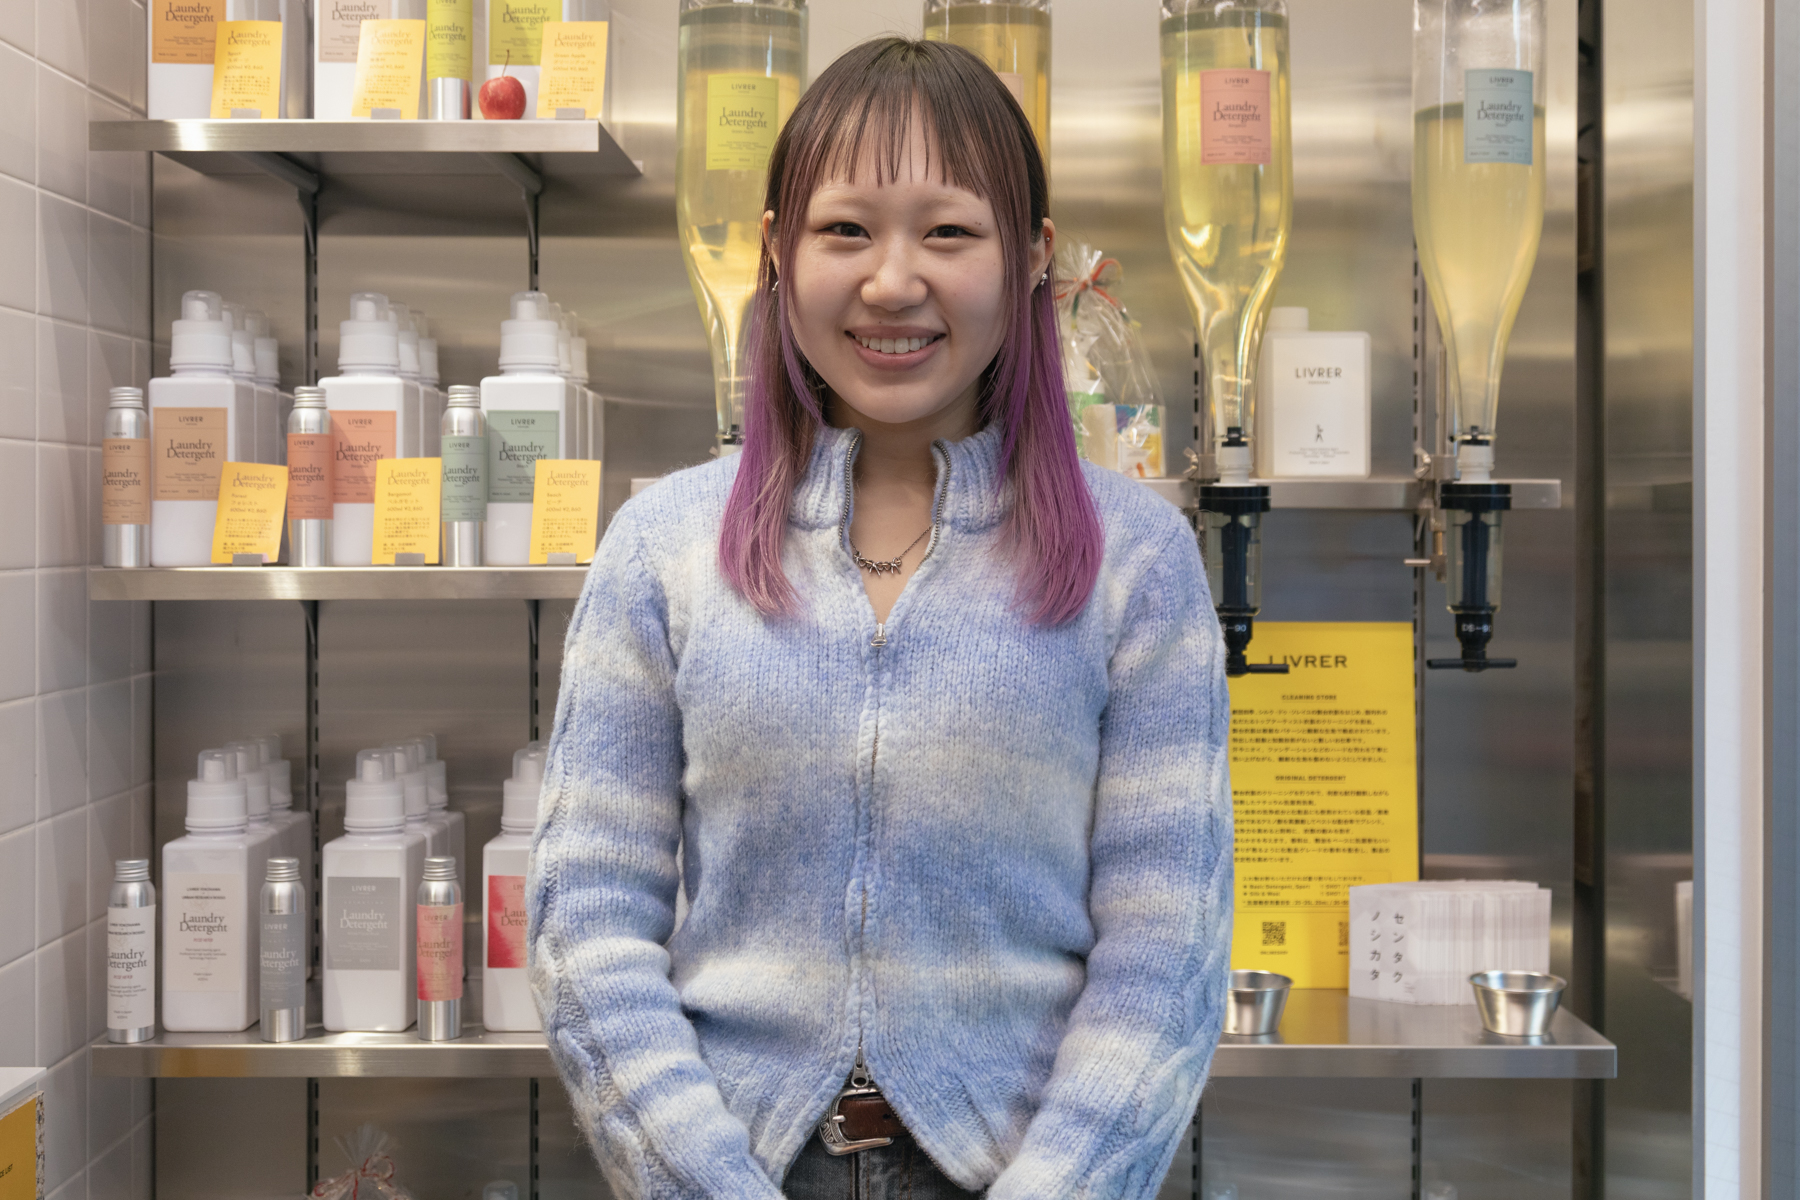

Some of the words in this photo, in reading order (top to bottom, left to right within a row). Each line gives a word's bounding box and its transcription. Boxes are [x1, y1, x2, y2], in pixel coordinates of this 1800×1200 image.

[168, 2, 211, 13] Laundry
[335, 1, 378, 12] Laundry
[505, 4, 548, 15] Laundry
[165, 11, 214, 25] Detergent
[331, 10, 380, 23] Detergent
[502, 12, 550, 26] Detergent
[430, 22, 465, 33] Laundry
[230, 30, 268, 40] Laundry
[429, 30, 467, 42] Detergent
[557, 32, 594, 42] Laundry
[554, 39, 596, 49] Detergent
[1216, 101, 1259, 113] Laundry
[1480, 100, 1522, 112] Laundry
[722, 106, 765, 119] Laundry
[1213, 110, 1261, 123] Detergent
[719, 116, 768, 130] Detergent
[1295, 367, 1342, 378] LIVRER
[347, 418, 373, 426] LIVRER
[510, 418, 536, 426] LIVRER
[170, 439, 213, 451] Laundry
[339, 441, 382, 453] Laundry
[502, 441, 545, 453] Laundry
[166, 448, 216, 462] Detergent
[335, 450, 384, 464] Detergent
[498, 450, 548, 464] Detergent
[103, 468, 139, 479] Laundry
[289, 464, 323, 475] Laundry
[391, 469, 428, 479] Laundry
[443, 465, 478, 476] Laundry
[550, 470, 587, 480] Laundry
[103, 476, 141, 488] Detergent
[236, 472, 275, 483] Laundry
[288, 472, 325, 483] Detergent
[387, 477, 430, 487] Detergent
[443, 472, 480, 484] Detergent
[546, 478, 589, 488] Detergent
[232, 478, 277, 490] Detergent
[1220, 623, 1247, 632] S-90
[183, 912, 225, 924] Laundry
[343, 909, 385, 921] Laundry
[504, 907, 526, 918] Laun
[339, 918, 388, 931] Detergent
[501, 916, 527, 926] Deter
[179, 921, 227, 935] Detergent
[1370, 911, 1381, 981] ノシカタ
[1394, 913, 1404, 983] センタク
[260, 947, 297, 959] Laundry
[418, 947, 457, 961] Deterge
[107, 957, 147, 972] etergent
